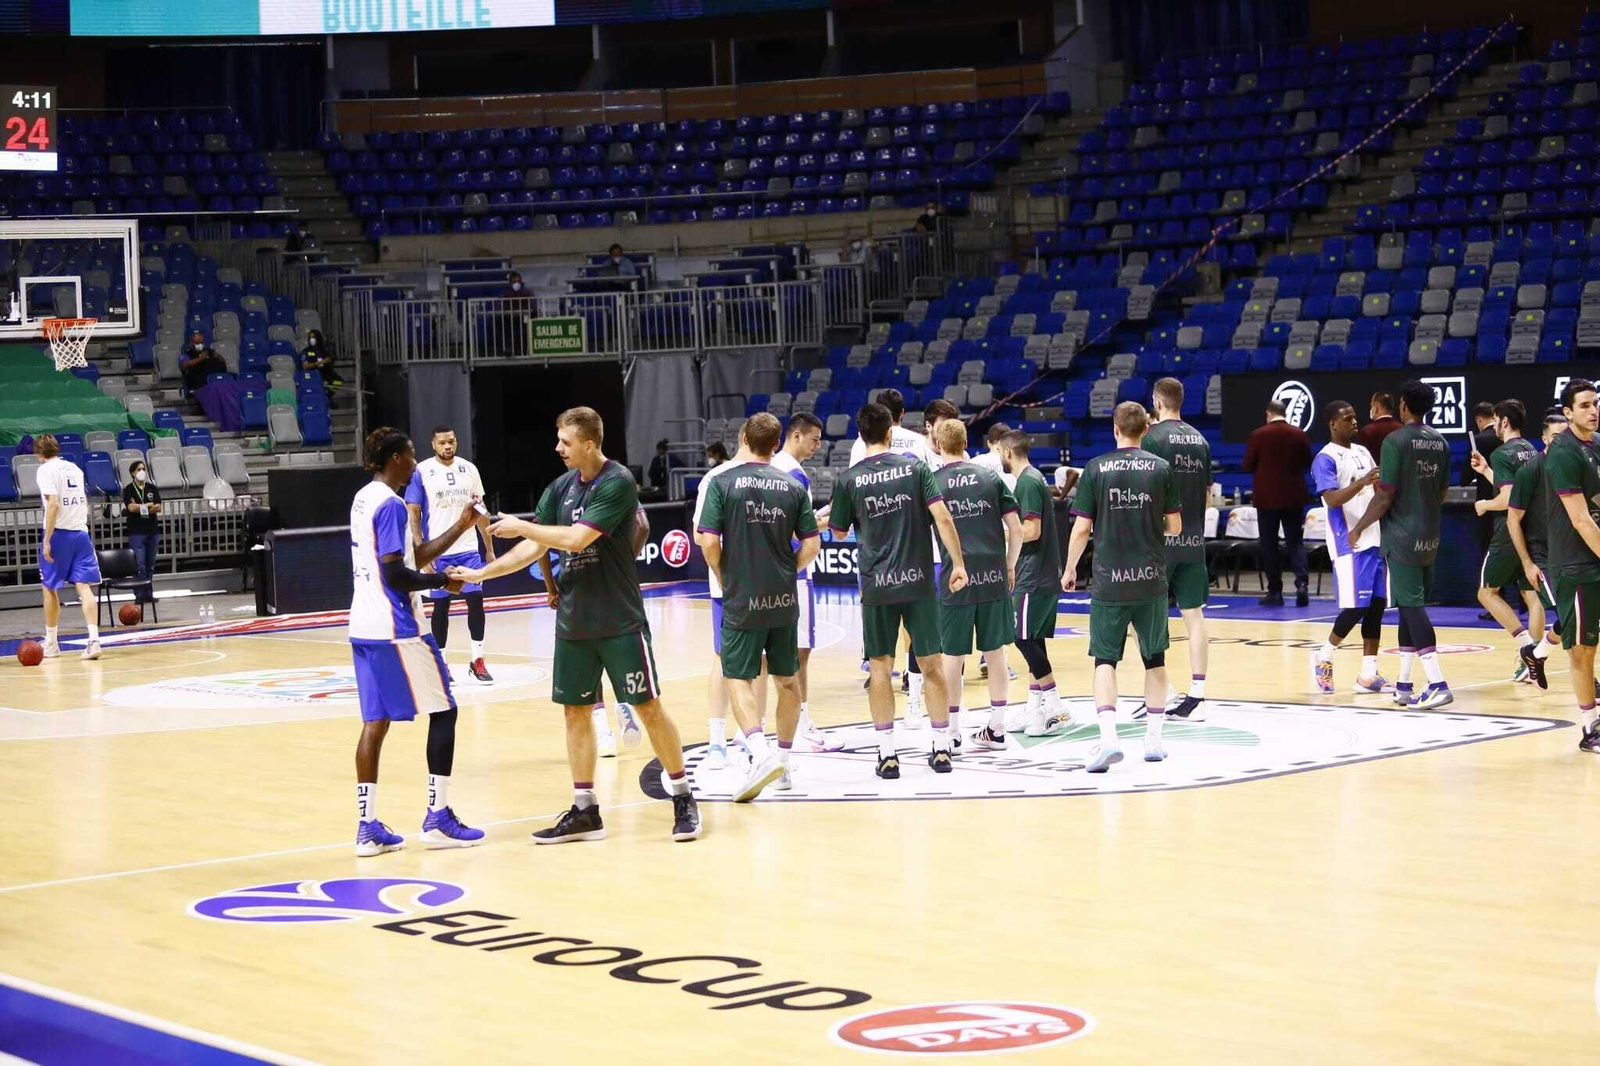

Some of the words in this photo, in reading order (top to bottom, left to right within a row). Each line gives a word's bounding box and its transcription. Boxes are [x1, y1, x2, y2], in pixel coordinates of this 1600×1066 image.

[323, 0, 492, 32] BOUTEILLE
[12, 91, 51, 109] 4:11
[6, 116, 50, 150] 24
[536, 325, 563, 337] SALIDA
[568, 325, 578, 336] DE
[533, 337, 582, 349] EMERGENCIA
[1411, 439, 1444, 451] THOMPSON
[1099, 457, 1156, 473] WACZYŃSKI
[446, 472, 456, 486] 9
[735, 477, 789, 492] ABROMAITIS
[855, 465, 913, 488] BOUTEILLE
[947, 473, 979, 489] DÍAZ
[864, 493, 912, 512] Málaga
[1109, 488, 1153, 506] Málaga
[745, 500, 787, 520] Málaga
[875, 567, 925, 588] MALAGA
[1111, 566, 1161, 583] MALAGA
[749, 592, 797, 611] MALAGA
[625, 671, 647, 695] 52
[372, 910, 873, 1011] EuroCup
[897, 1019, 1072, 1049] DAYS
